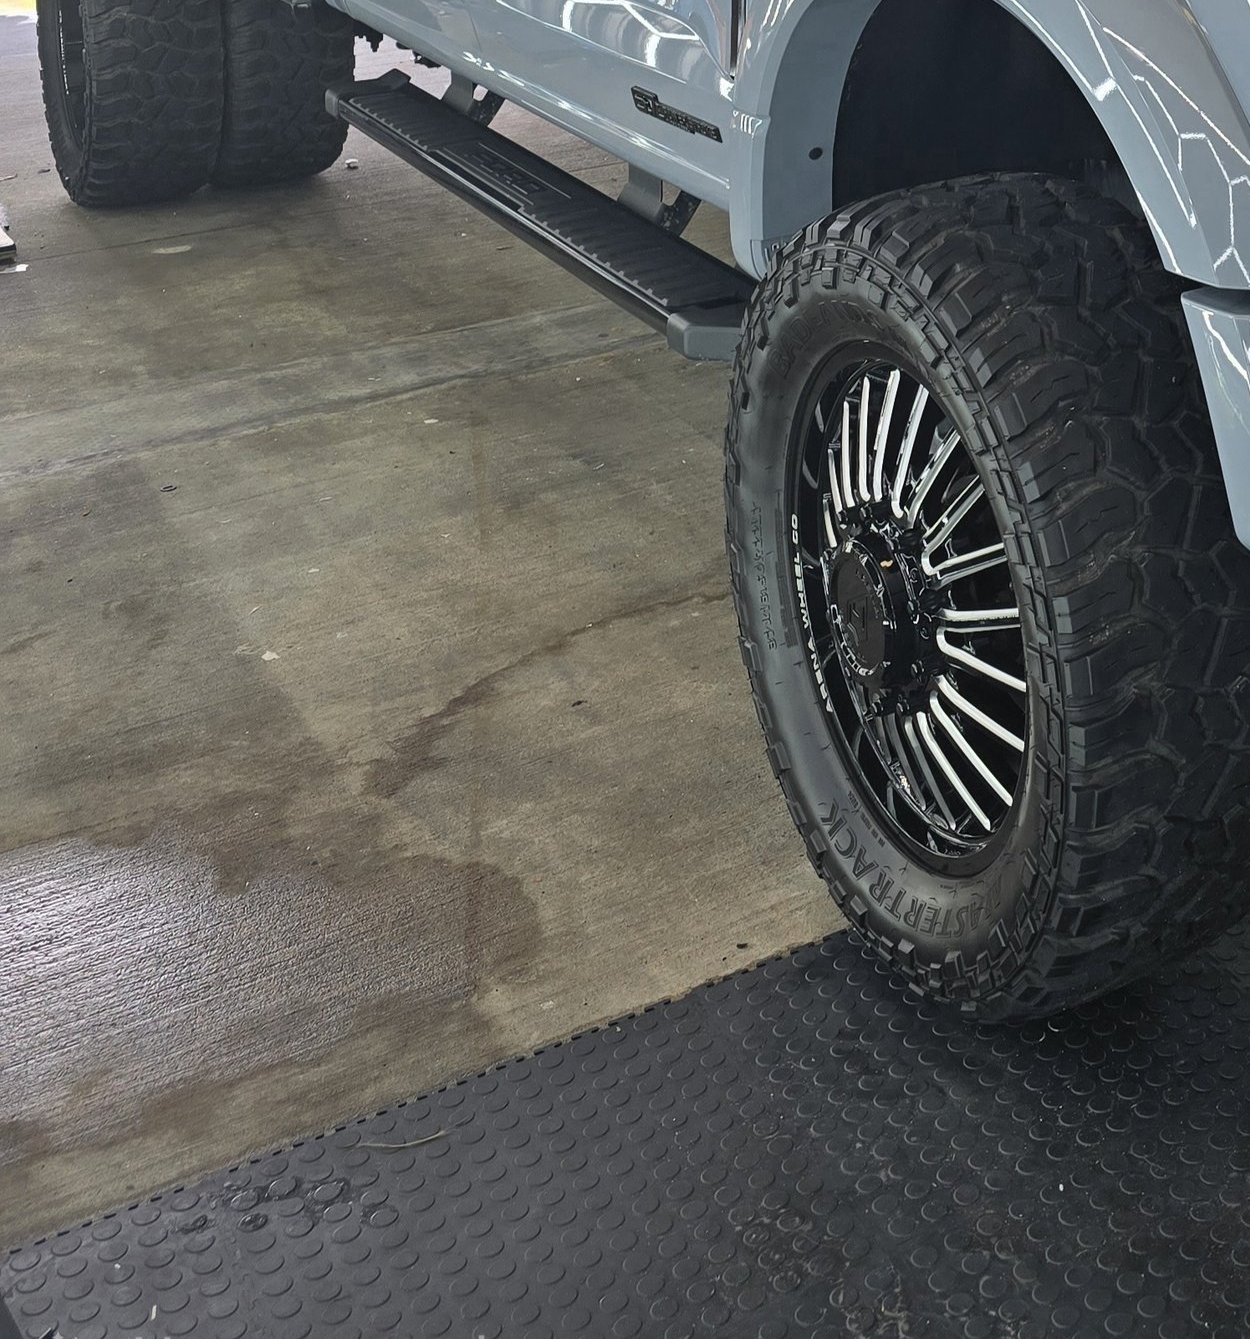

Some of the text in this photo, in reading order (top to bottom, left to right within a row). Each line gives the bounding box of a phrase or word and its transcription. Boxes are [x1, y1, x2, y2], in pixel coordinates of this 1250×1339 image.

[791, 513, 834, 713] ARENA WHEEL CO
